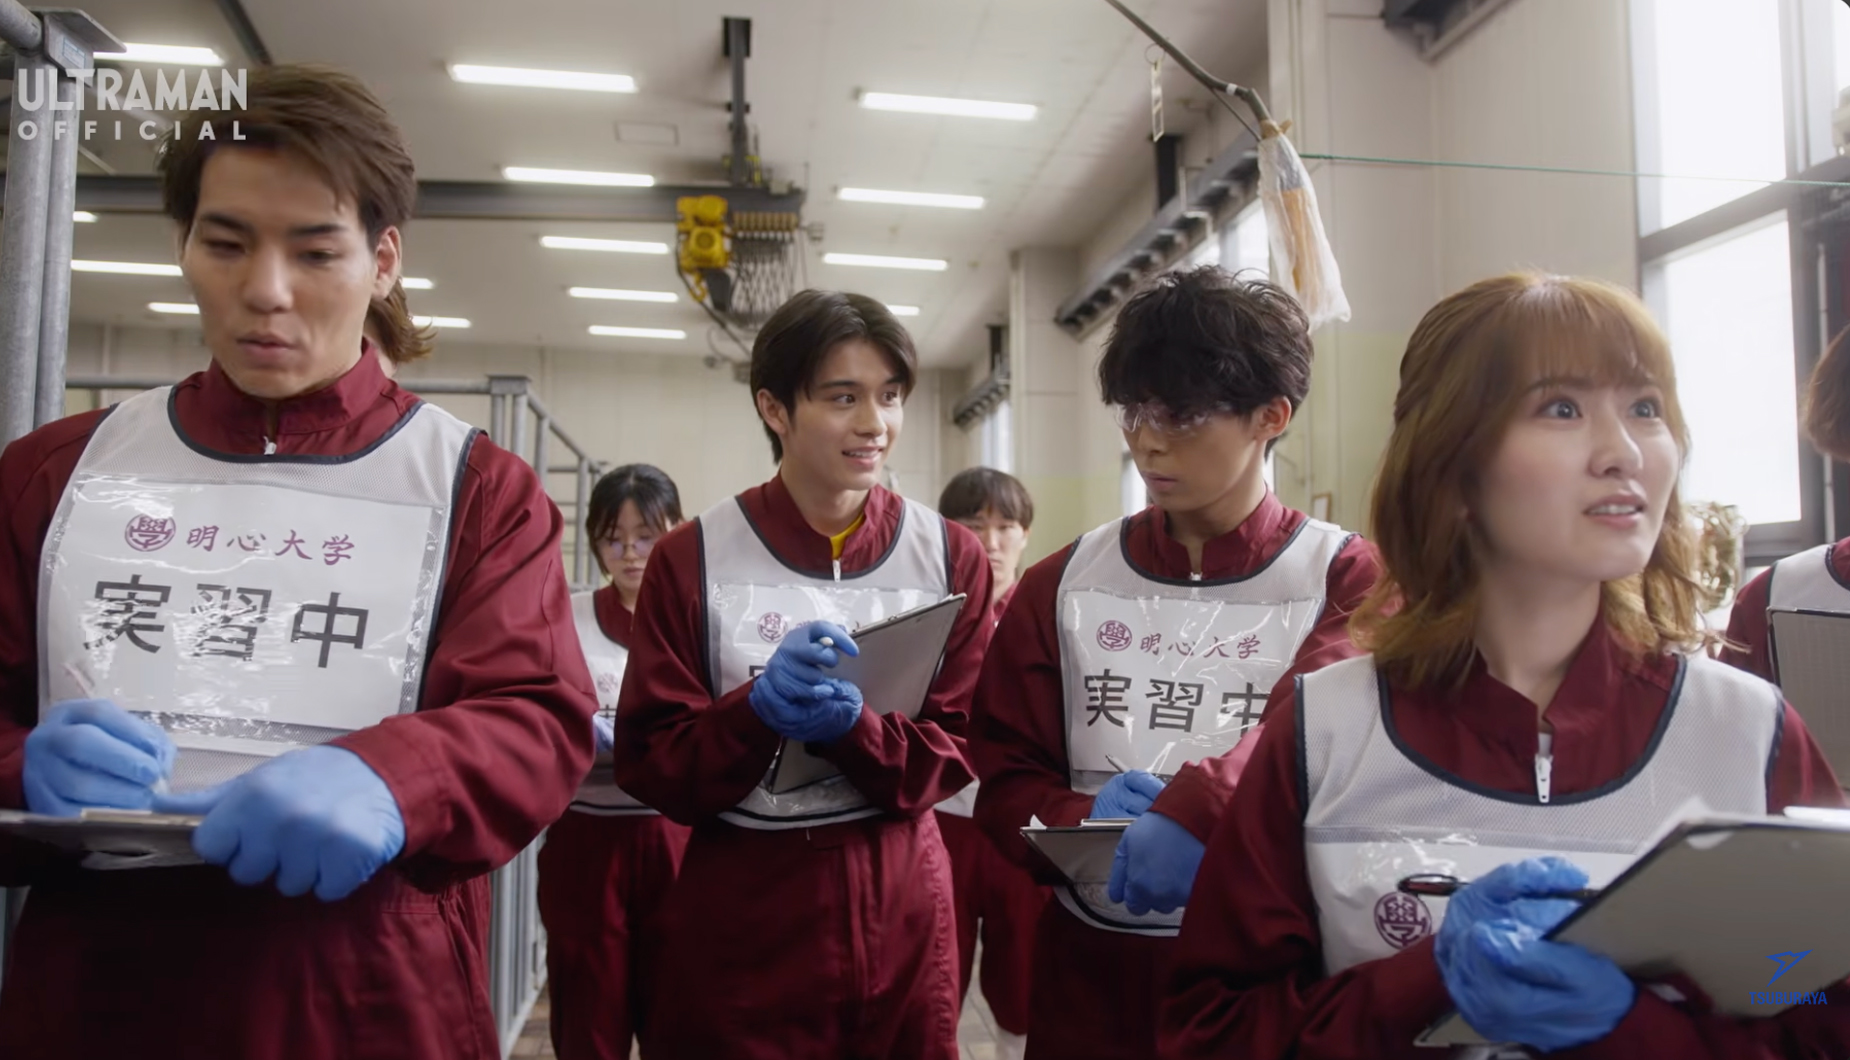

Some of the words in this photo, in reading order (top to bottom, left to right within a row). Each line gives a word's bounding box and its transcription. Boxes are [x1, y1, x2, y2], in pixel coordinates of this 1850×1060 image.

[186, 524, 355, 566] 明心大学
[83, 573, 370, 669] 実習中
[1140, 632, 1262, 660] 明心大学
[1083, 668, 1271, 738] 実習中
